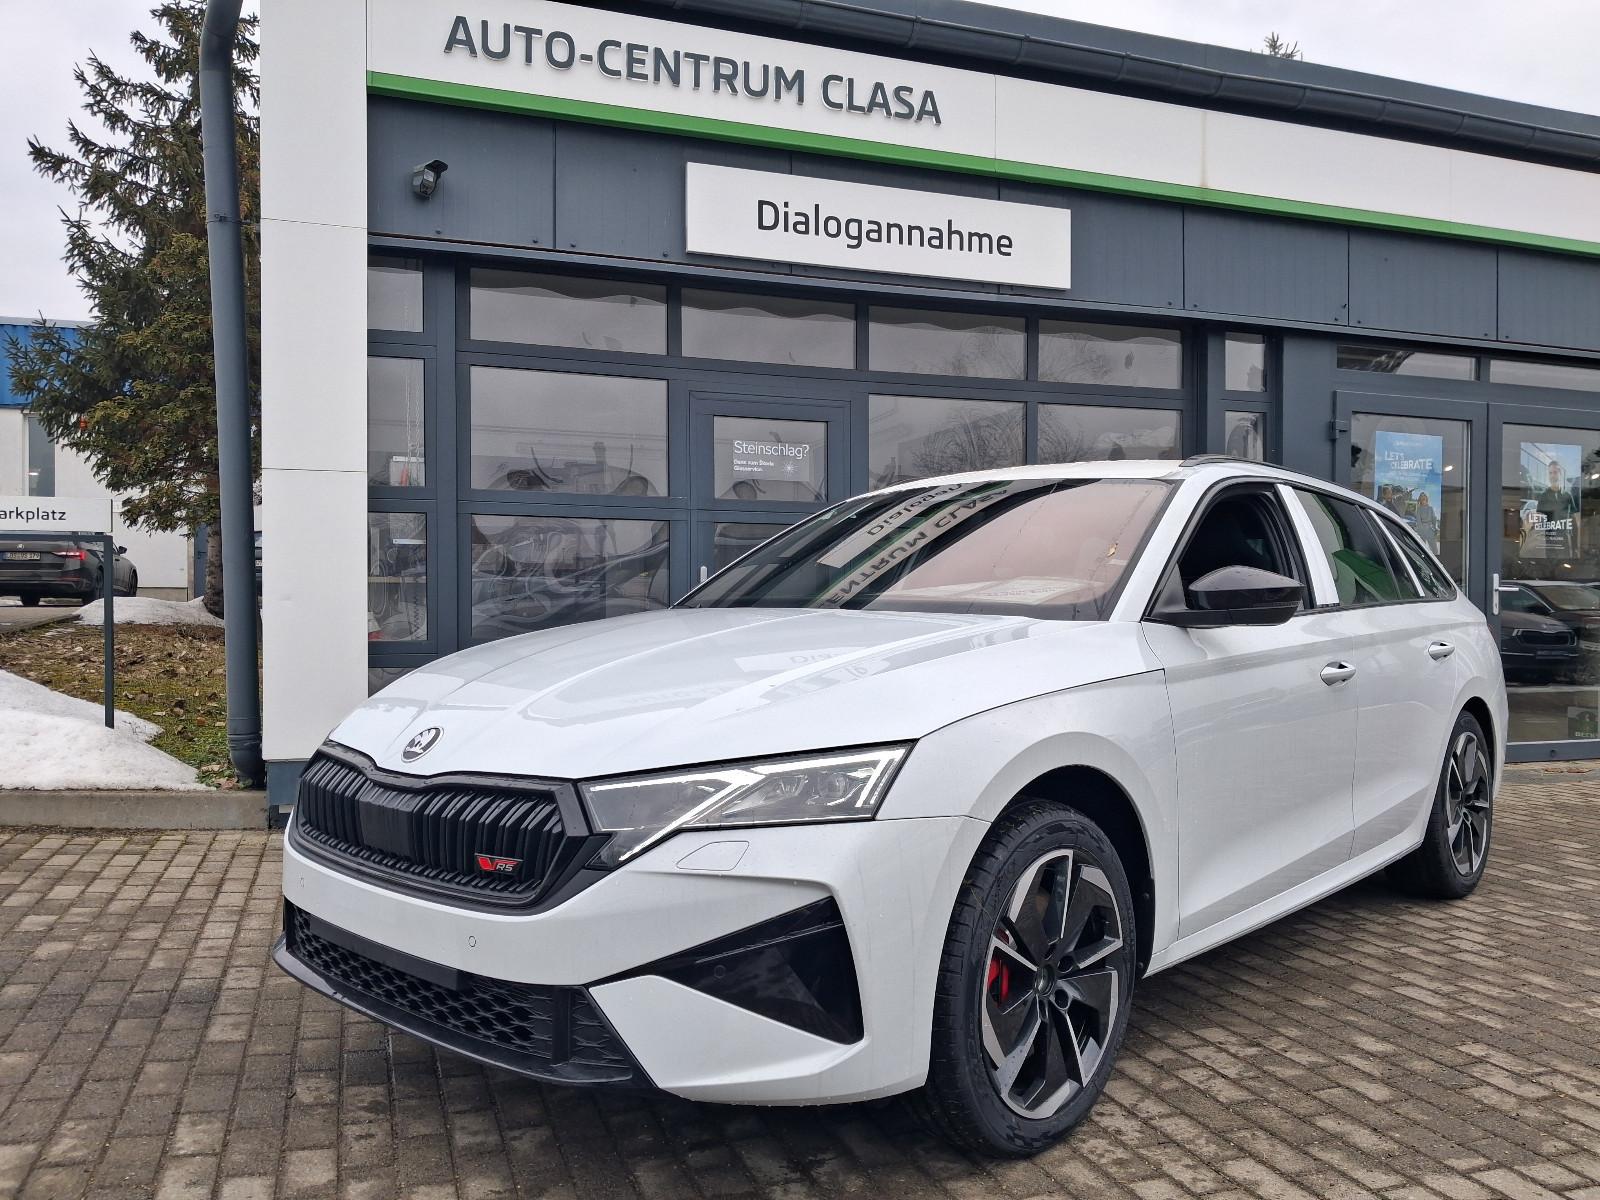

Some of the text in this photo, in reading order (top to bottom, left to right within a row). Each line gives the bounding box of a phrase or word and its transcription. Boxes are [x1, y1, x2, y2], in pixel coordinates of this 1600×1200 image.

[443, 15, 942, 126] AUTO-CENTRUM CLASA
[757, 199, 1013, 256] Dialogannahme
[734, 440, 809, 460] Steinschlag?
[1391, 458, 1433, 470] CELEBRATE
[1534, 518, 1573, 531] CELEBRATE
